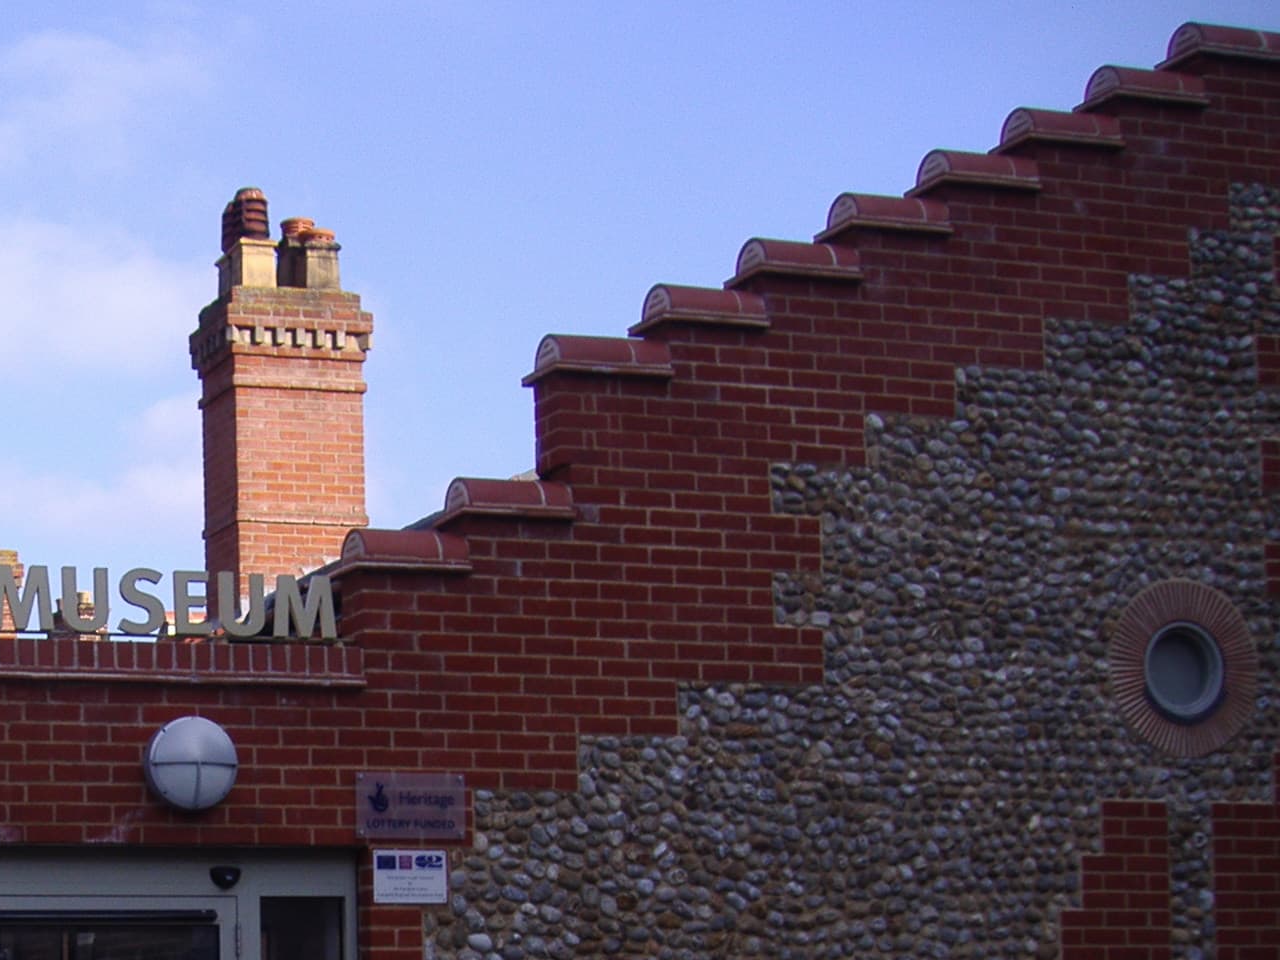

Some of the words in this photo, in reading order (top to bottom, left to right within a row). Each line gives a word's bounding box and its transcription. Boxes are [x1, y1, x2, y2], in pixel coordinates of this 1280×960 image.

[399, 791, 455, 809] Heritage
[367, 818, 410, 829] LOTTERY
[414, 818, 455, 829] FUNDED
